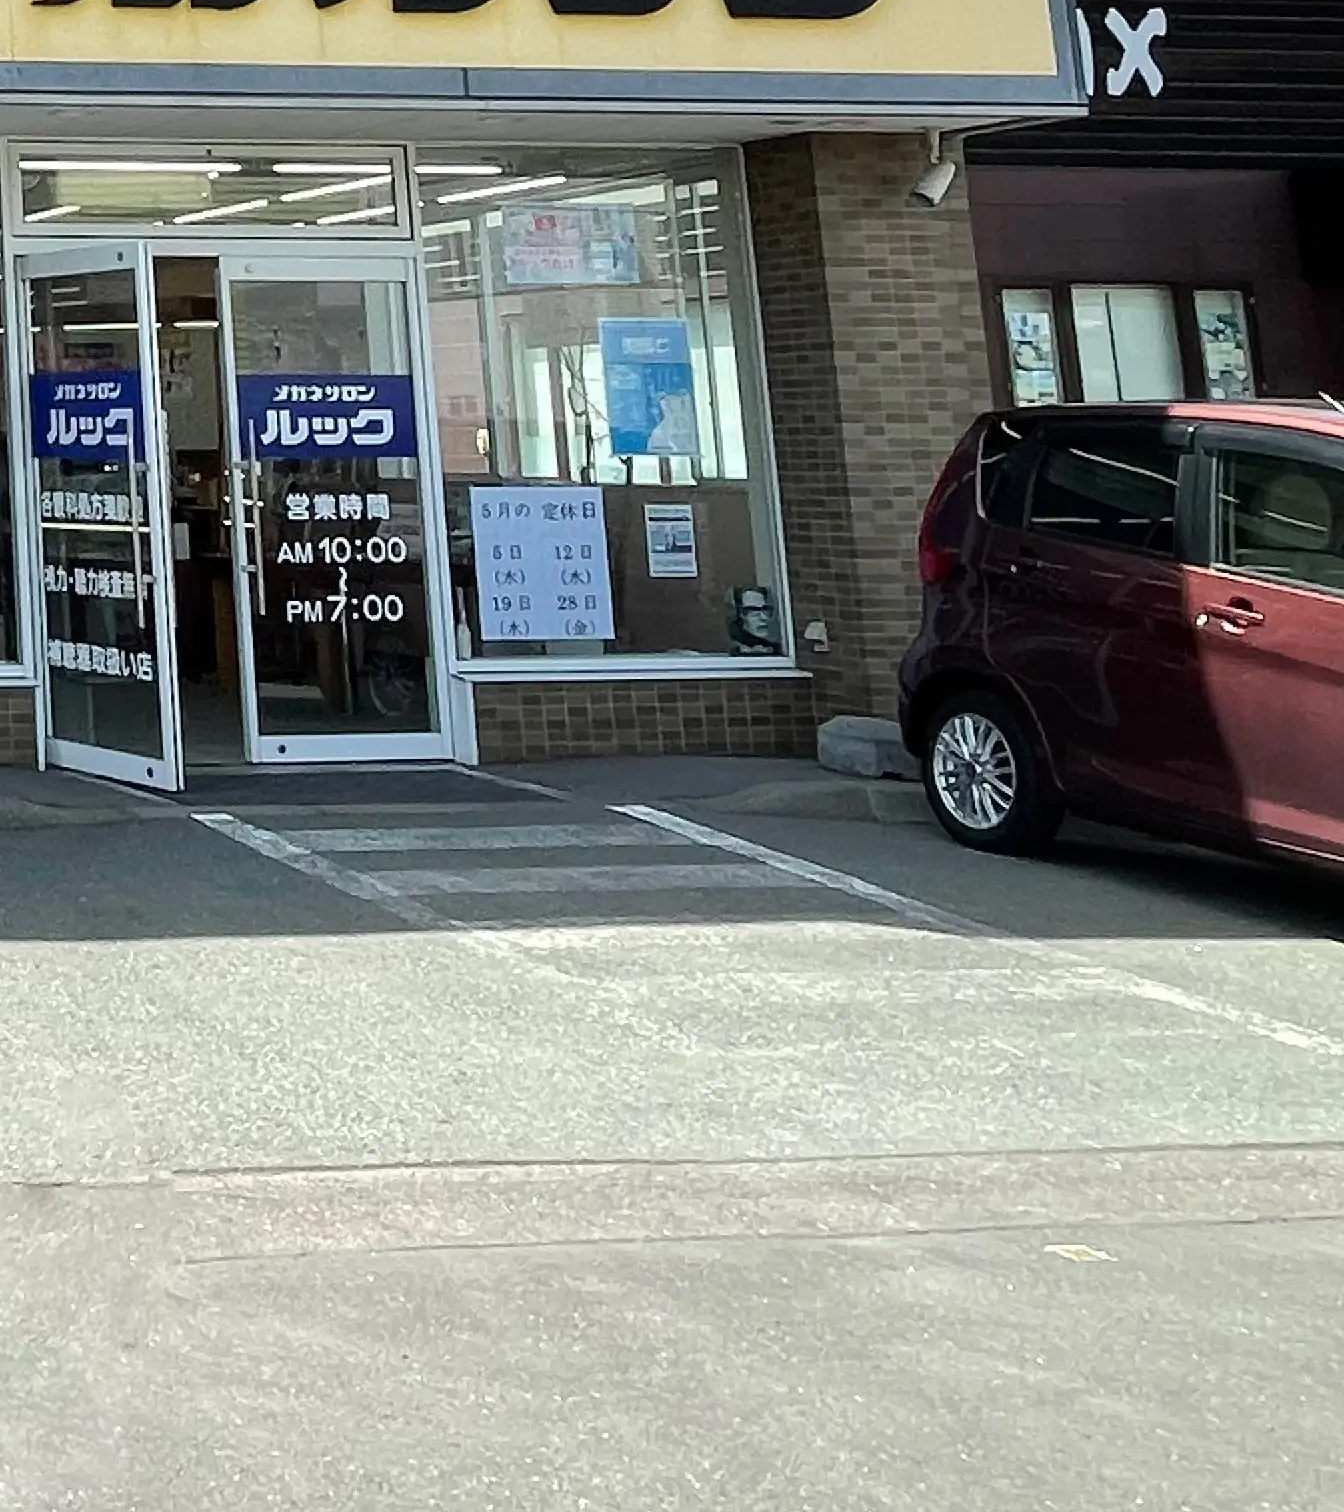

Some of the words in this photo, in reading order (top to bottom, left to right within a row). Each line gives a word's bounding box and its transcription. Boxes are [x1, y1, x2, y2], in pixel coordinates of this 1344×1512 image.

[272, 384, 376, 403] メガネサロン
[46, 407, 135, 446] ルック
[260, 408, 395, 446] ルック
[286, 492, 391, 521] 営業時間
[276, 541, 314, 564] AM
[318, 536, 408, 564] 10:00
[286, 600, 324, 624] PM
[326, 594, 405, 623] 7:00
